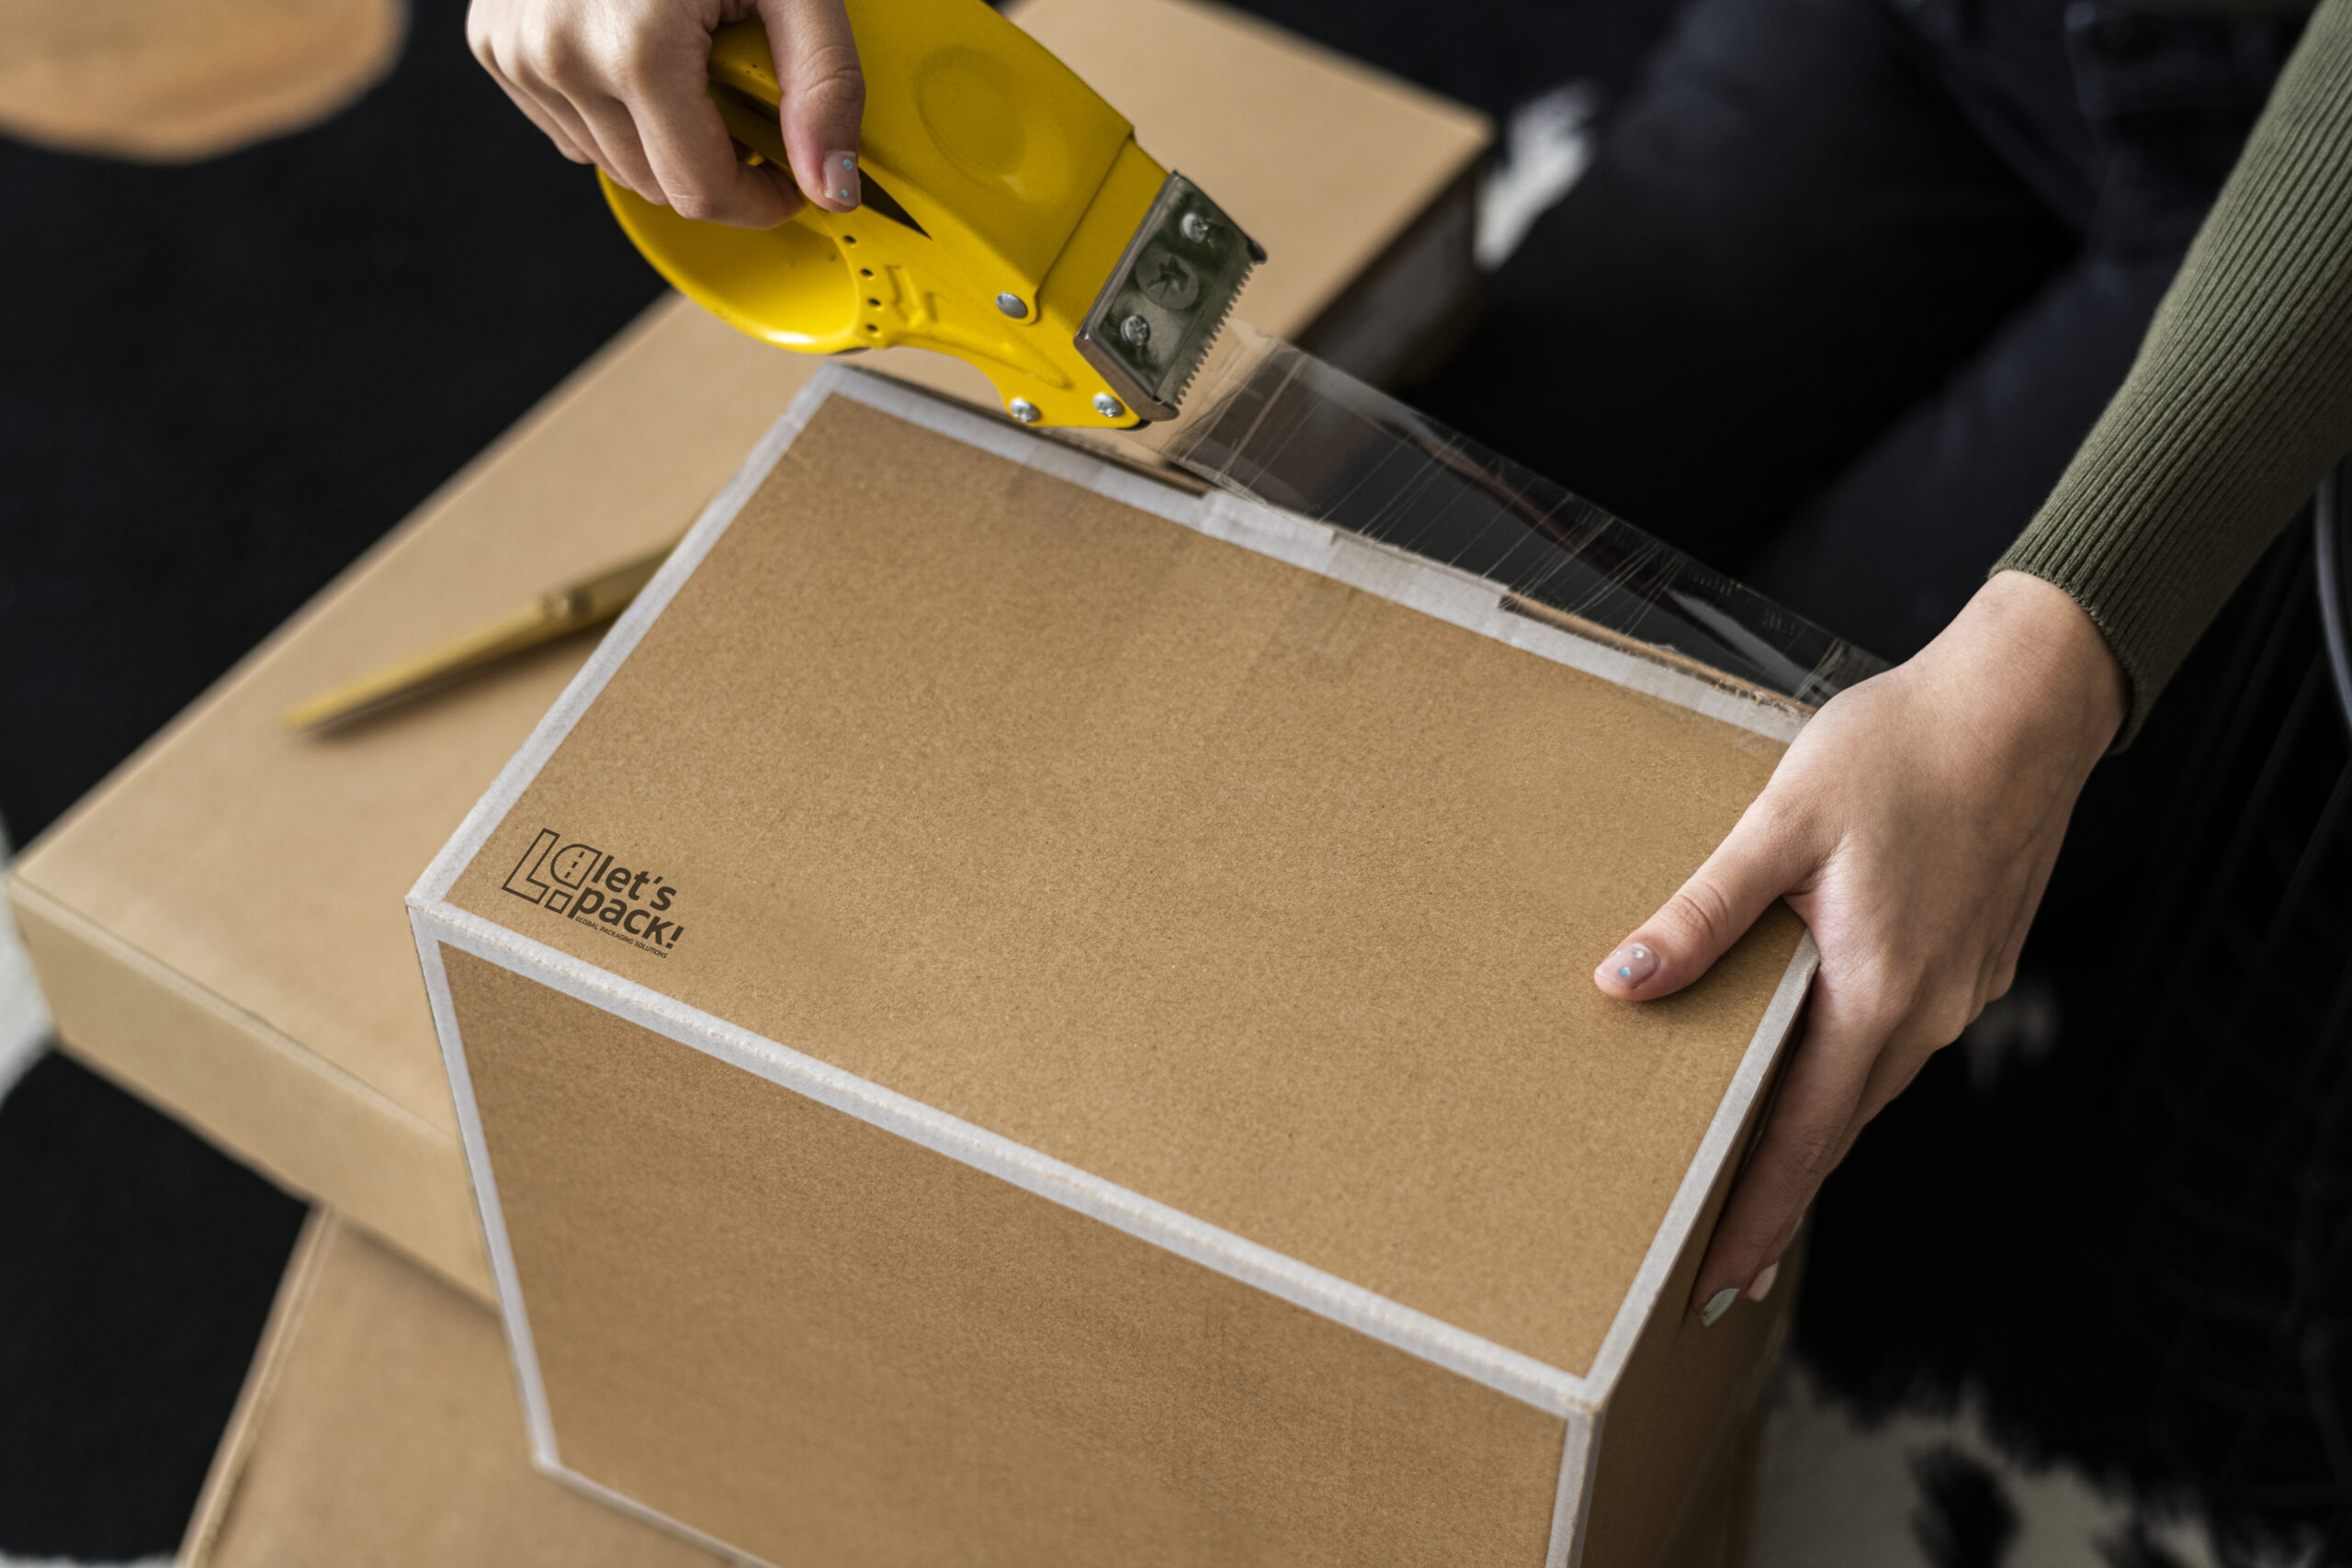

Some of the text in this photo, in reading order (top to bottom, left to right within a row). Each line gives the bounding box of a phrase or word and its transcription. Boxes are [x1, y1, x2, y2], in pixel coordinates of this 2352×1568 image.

[591, 855, 677, 911] let's
[567, 886, 684, 950] pack!
[575, 916, 668, 959] GLOBAL PACKAGING SOLUTIONS
